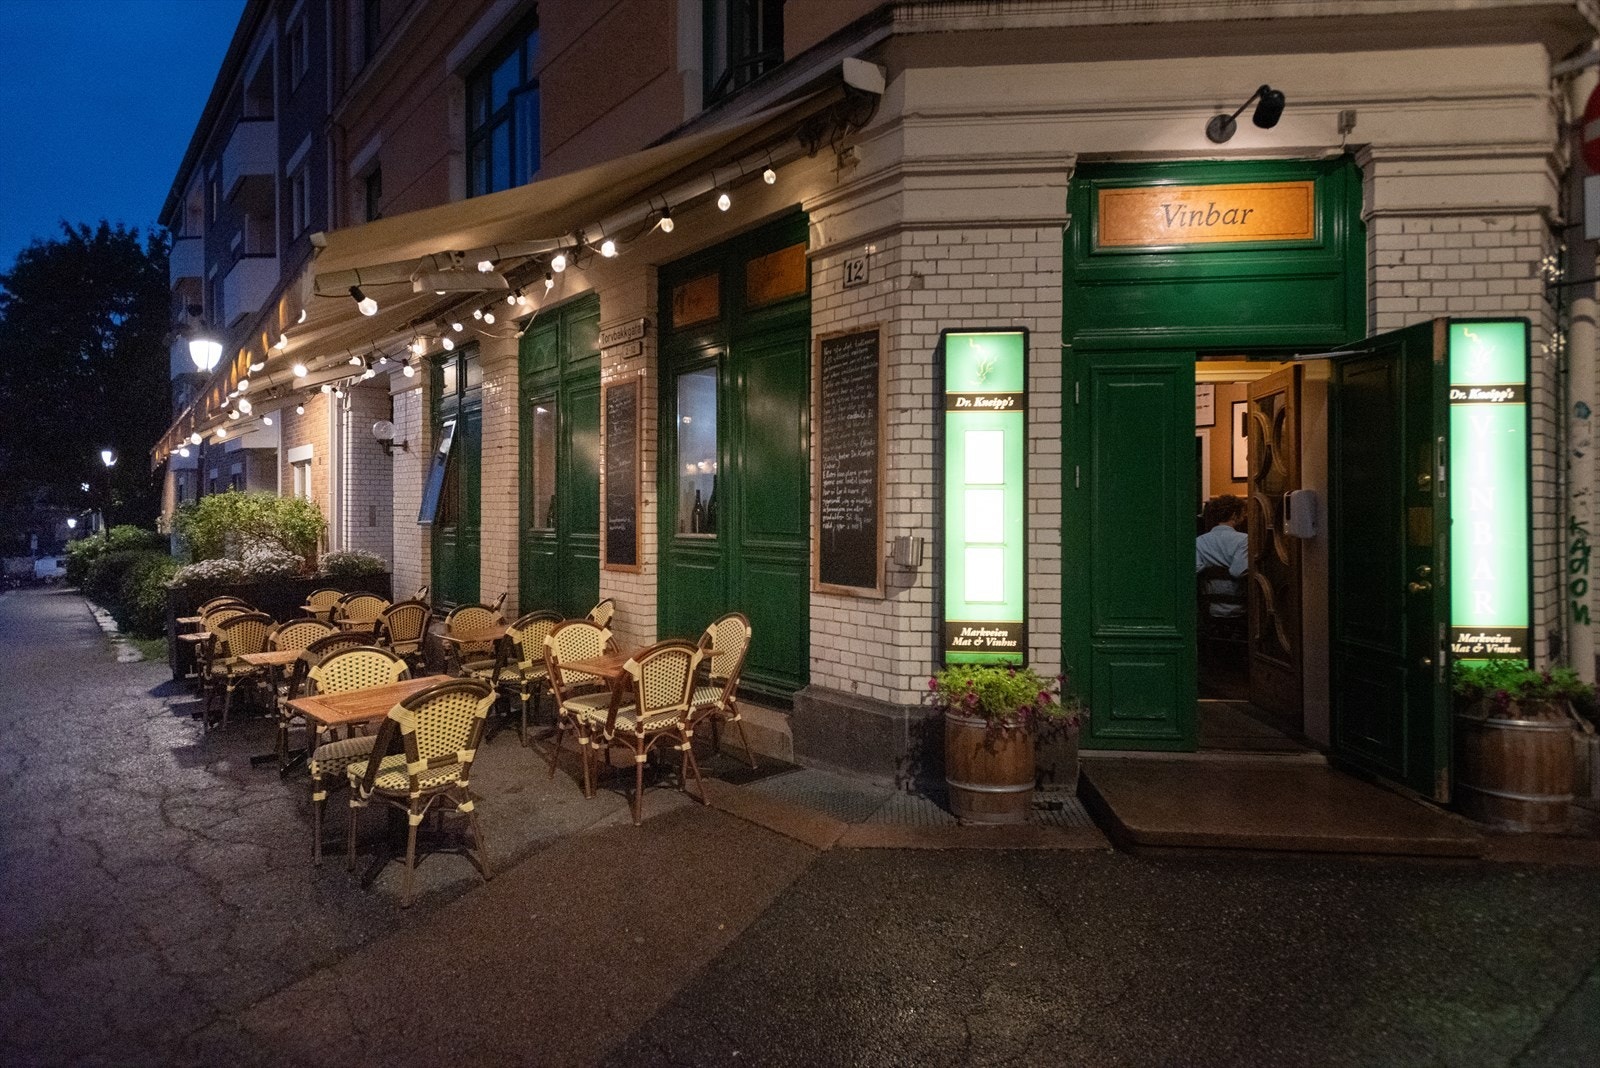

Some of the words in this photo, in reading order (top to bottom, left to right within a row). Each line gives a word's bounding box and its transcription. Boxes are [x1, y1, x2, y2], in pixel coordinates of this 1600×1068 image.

[1160, 202, 1254, 229] Vinbar
[846, 259, 865, 284] 12
[601, 325, 641, 345] Torvbakkgata
[1450, 389, 1467, 400] Dr.
[1467, 387, 1514, 402] Kneipp's
[955, 397, 972, 407] Dr.
[973, 396, 1014, 410] Kneipp's
[1468, 415, 1497, 615] VINBAR
[960, 627, 1008, 637] Markveien
[1457, 632, 1512, 643] Markveien
[952, 637, 972, 646] Mat
[973, 637, 984, 646] &
[986, 637, 1017, 647] Vinhus
[1472, 643, 1484, 654] &
[1486, 643, 1522, 654] Vinhus
